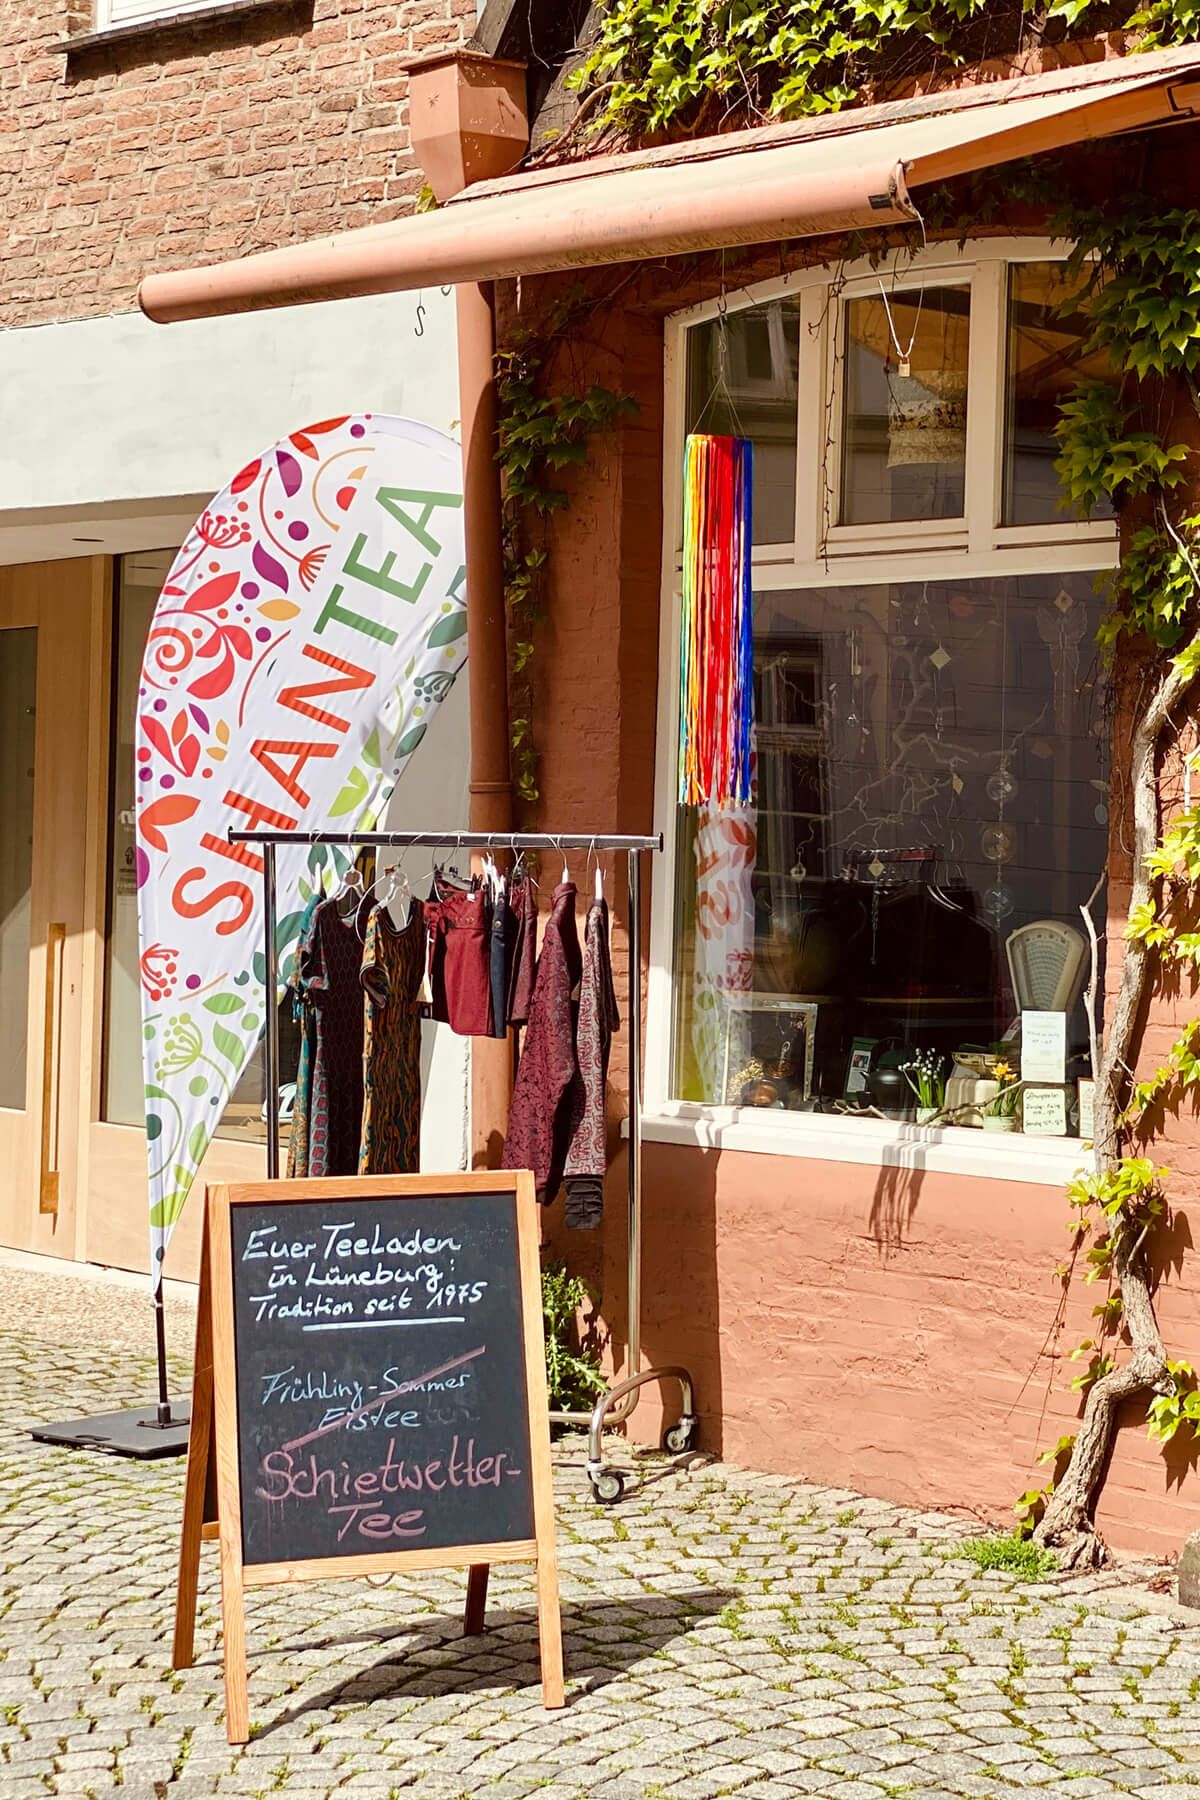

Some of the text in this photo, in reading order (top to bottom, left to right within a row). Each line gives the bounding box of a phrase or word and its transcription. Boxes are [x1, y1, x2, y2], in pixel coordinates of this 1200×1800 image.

[171, 486, 464, 936] SHANTEA
[242, 1225, 317, 1261] Euer
[268, 1264, 297, 1288] in
[249, 1281, 488, 1321] Tradition seit 1975
[318, 1400, 422, 1432] Eistee
[328, 1500, 427, 1542] Tee
